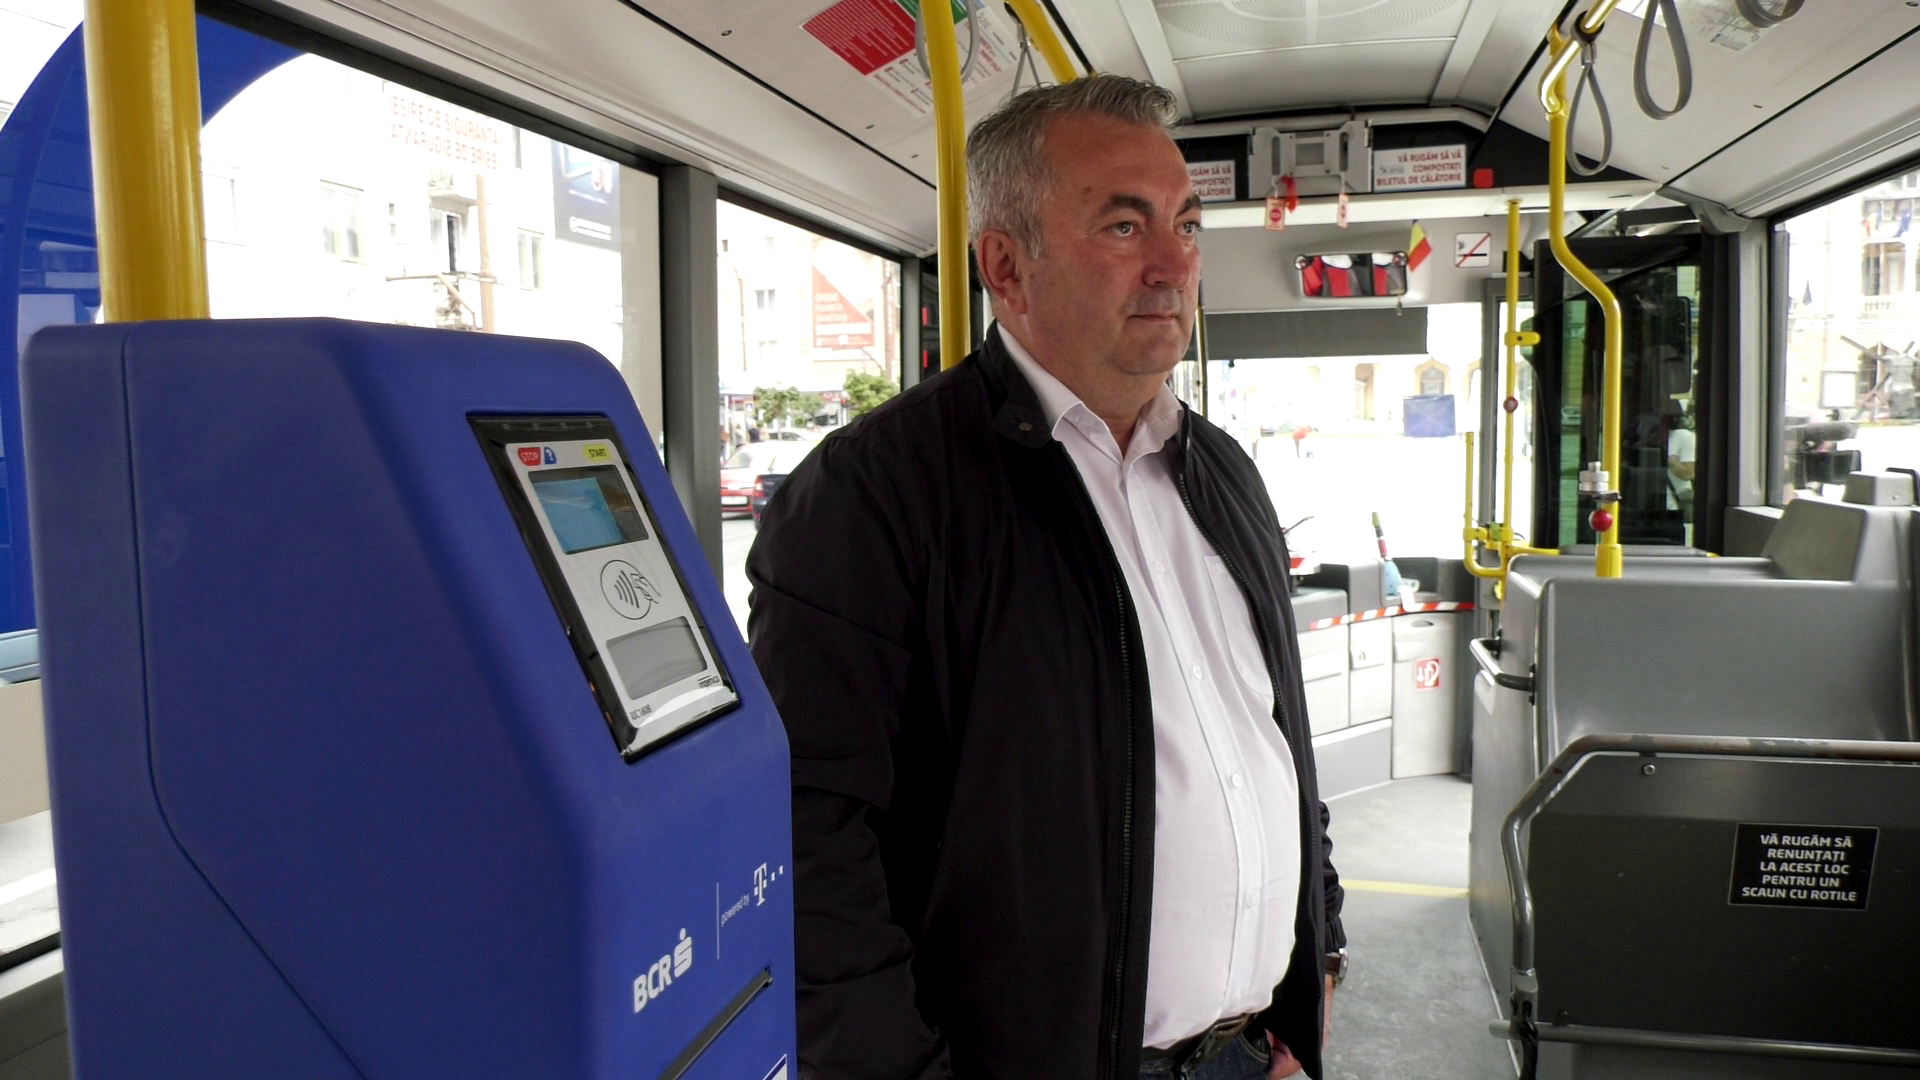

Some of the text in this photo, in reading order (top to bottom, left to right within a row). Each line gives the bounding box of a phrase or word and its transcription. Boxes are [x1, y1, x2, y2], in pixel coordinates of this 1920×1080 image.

[428, 107, 441, 129] DE
[1410, 151, 1438, 162] RUGĂM
[1451, 149, 1462, 159] VĂ
[1189, 165, 1209, 176] UGĂM
[1191, 177, 1232, 187] OMPOSTAȚI
[1377, 176, 1407, 187] BILETUL
[1408, 175, 1419, 184] DE
[520, 452, 539, 462] STOP
[588, 448, 607, 458] START
[1760, 833, 1853, 848] VĂ RUGĂM SĂ
[1767, 848, 1845, 862] RENUNȚAȚI
[1760, 861, 1849, 874] LA ACEST LOC
[1762, 875, 1840, 888] PENTRU UN
[1742, 887, 1857, 902] SCAUN CU ROTILE
[721, 897, 743, 927] powered
[743, 893, 750, 907] by
[633, 954, 672, 1014] BCR
